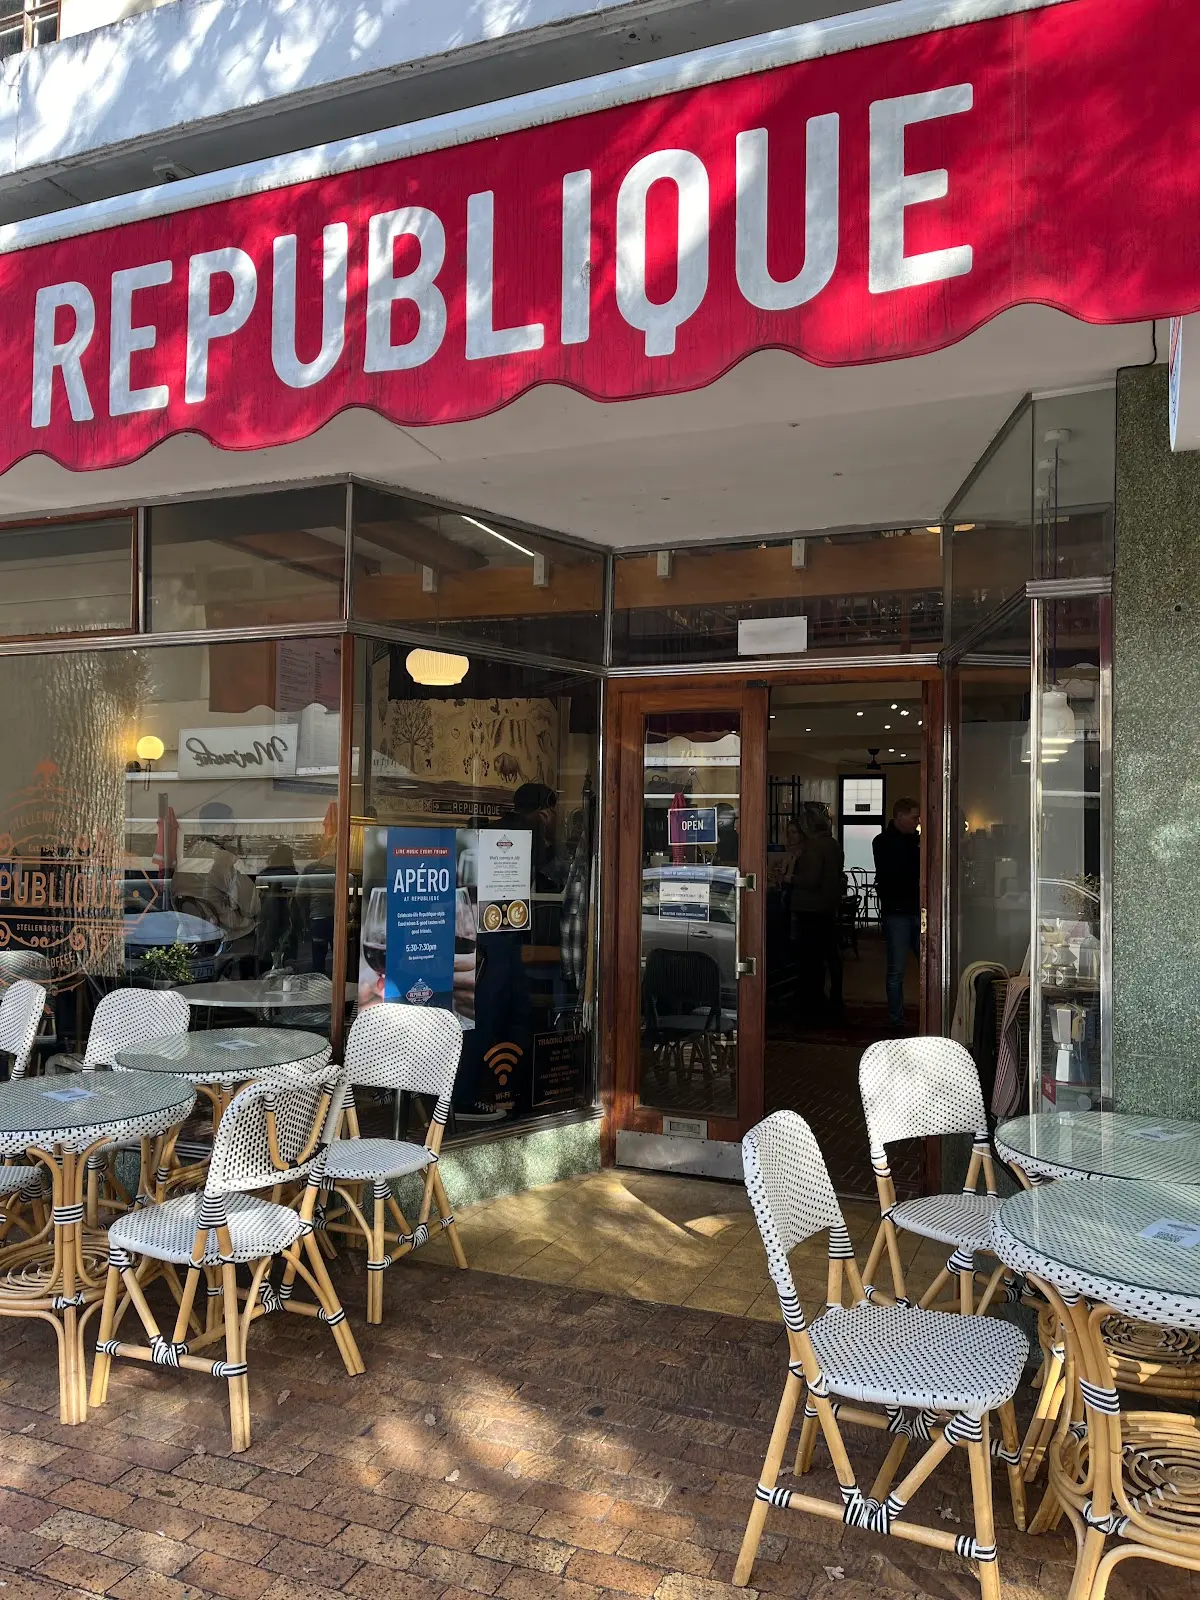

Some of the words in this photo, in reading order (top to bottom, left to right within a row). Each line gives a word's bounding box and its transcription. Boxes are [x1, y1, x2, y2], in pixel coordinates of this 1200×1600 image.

[31, 82, 973, 428] REPUBLIQUE
[452, 802, 501, 815] REPUBLIQUE
[681, 819, 704, 831] OPEN
[393, 862, 450, 893] APÉRO
[16, 923, 64, 933] STELLENBOSCH
[405, 943, 437, 952] 5:30-7:30pm
[45, 950, 76, 968] COFFEE
[537, 1036, 563, 1046] TRADING
[563, 1033, 584, 1043] HOURS
